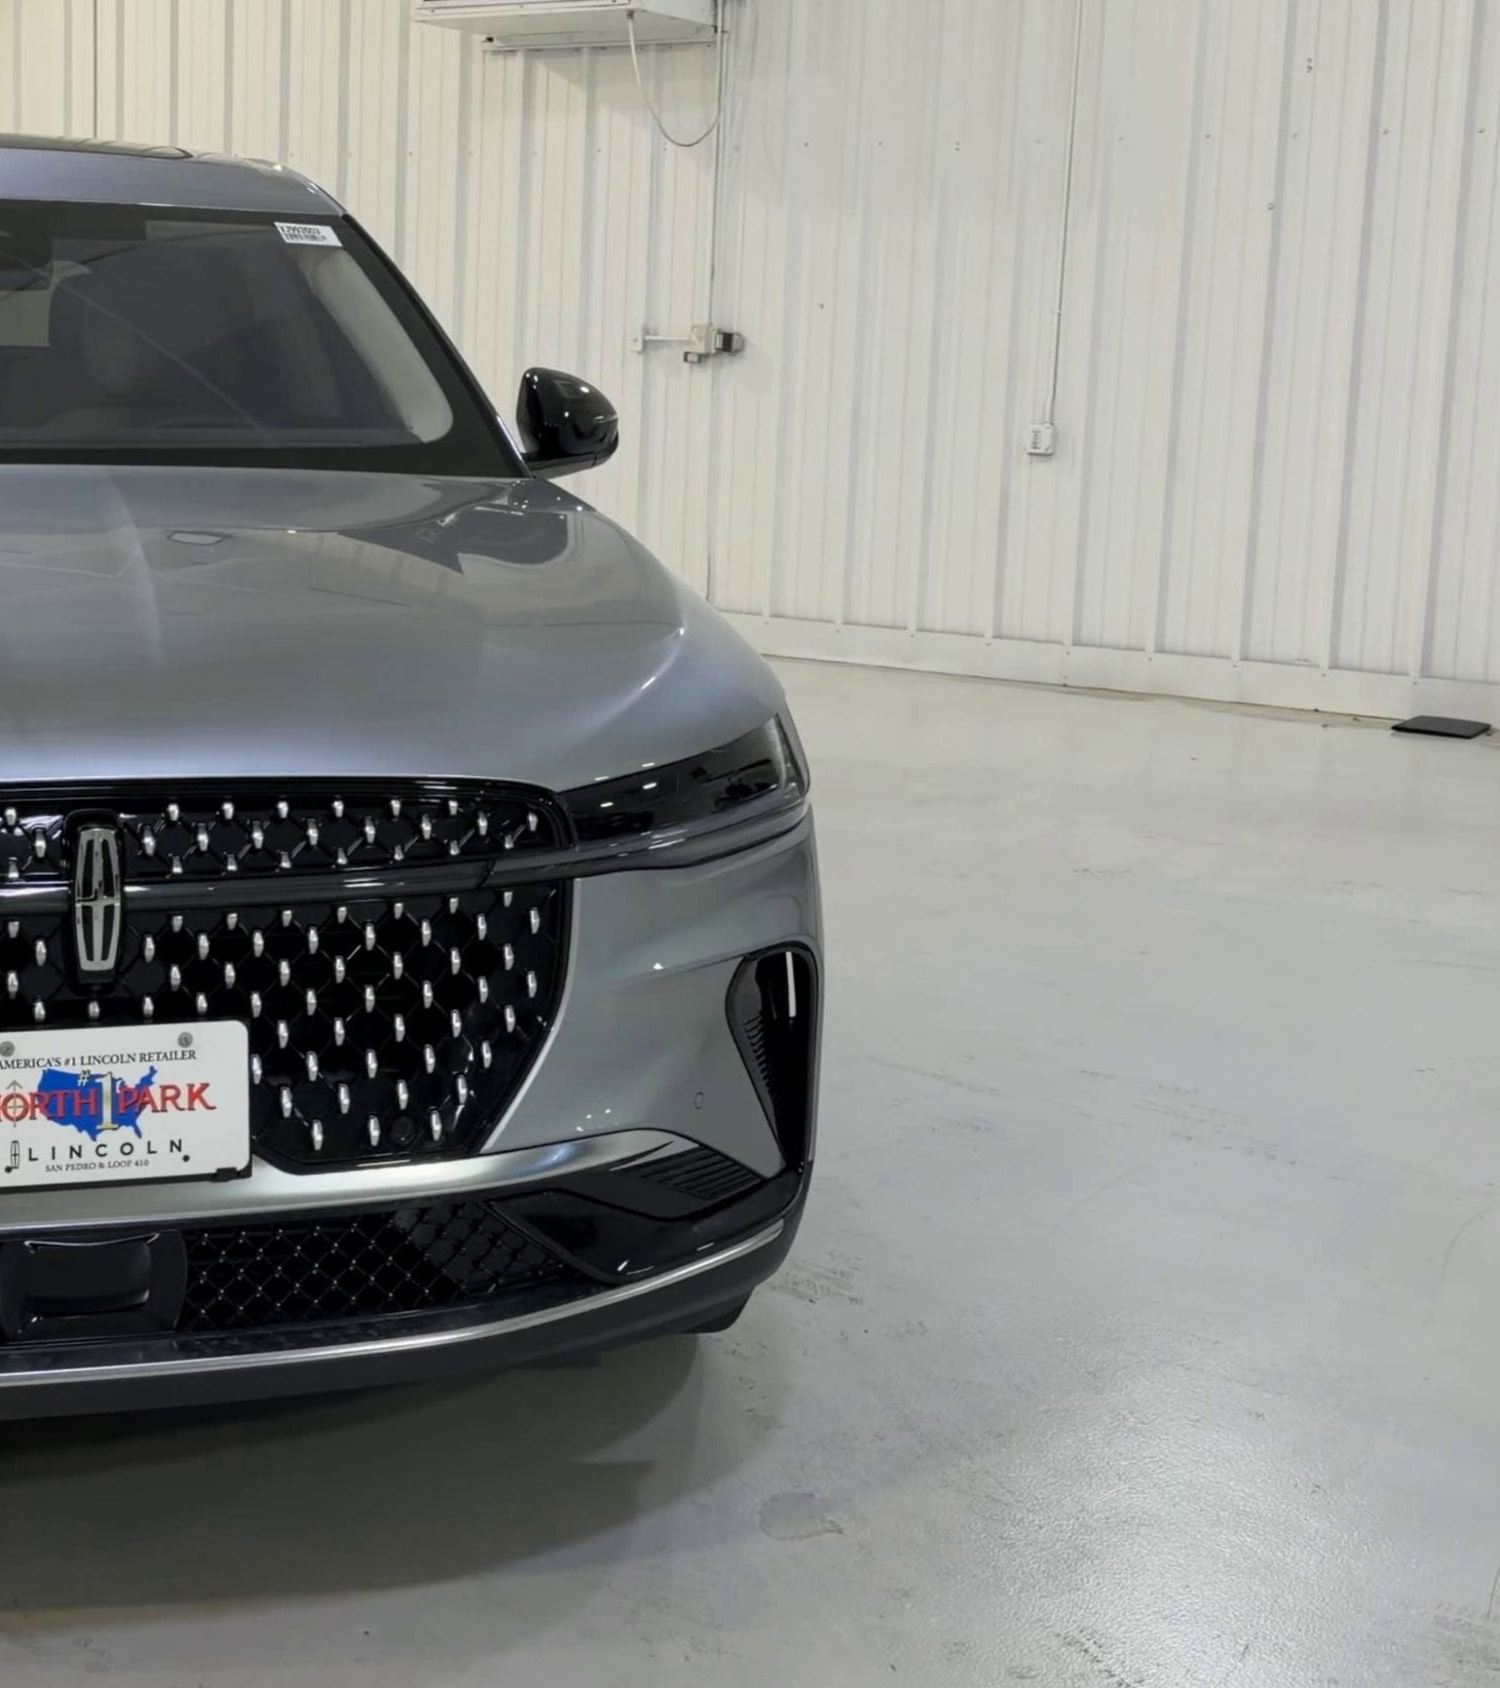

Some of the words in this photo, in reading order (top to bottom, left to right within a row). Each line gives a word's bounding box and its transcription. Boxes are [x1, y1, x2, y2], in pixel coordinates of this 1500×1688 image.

[64, 1056, 77, 1067] #1
[79, 1053, 137, 1066] LINCOLN
[139, 1049, 198, 1063] RETAILER
[117, 1082, 218, 1114] PARK
[28, 1138, 183, 1162] LINCOLN
[45, 1164, 64, 1173] SAN
[65, 1162, 97, 1172] PEDRO
[107, 1160, 133, 1169] LOOP
[134, 1158, 150, 1167] 410
